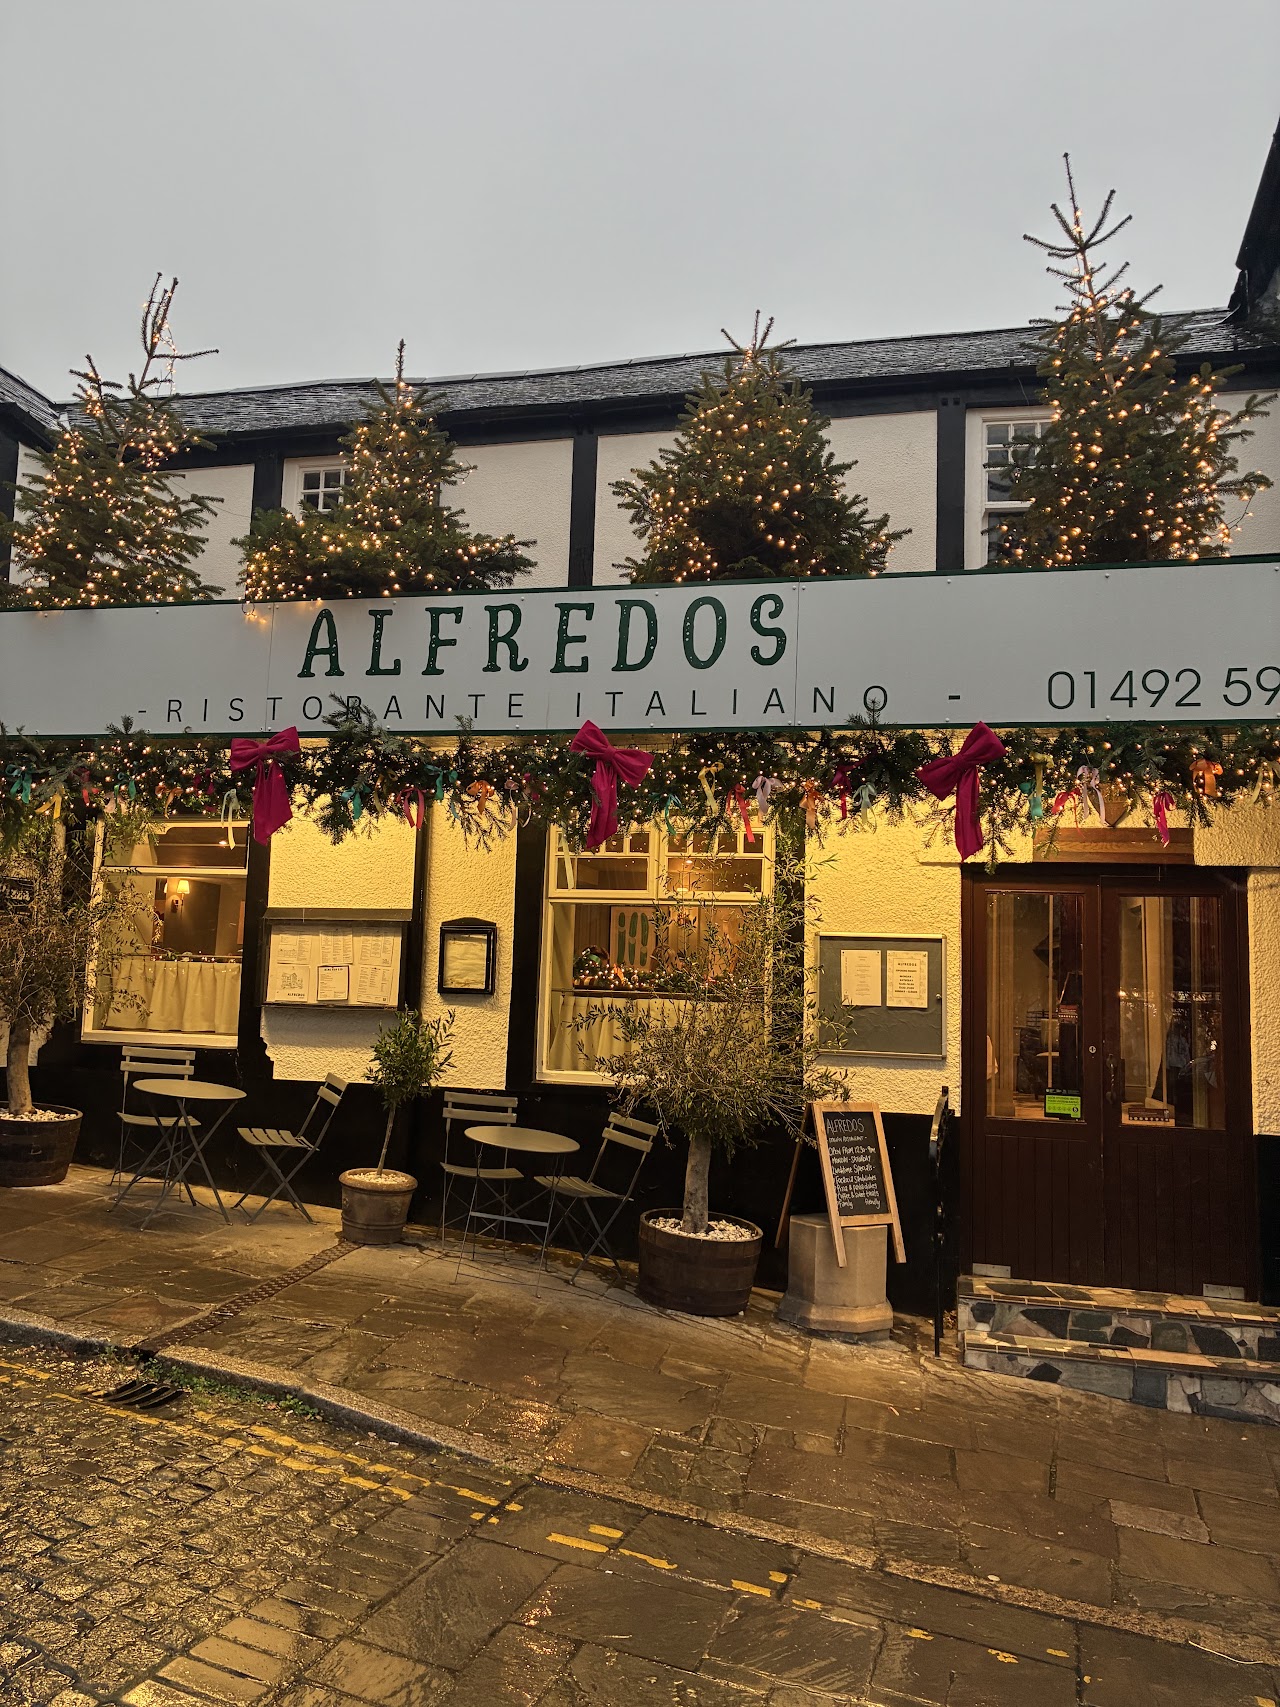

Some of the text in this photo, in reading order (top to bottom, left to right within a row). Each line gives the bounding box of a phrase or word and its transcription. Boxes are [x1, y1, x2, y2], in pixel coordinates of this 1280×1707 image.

[297, 593, 787, 678] ALFREDOS
[576, 685, 888, 718] ITALIANO
[1047, 666, 1280, 710] 01492 59
[826, 1118, 865, 1134] ALFREDOS
